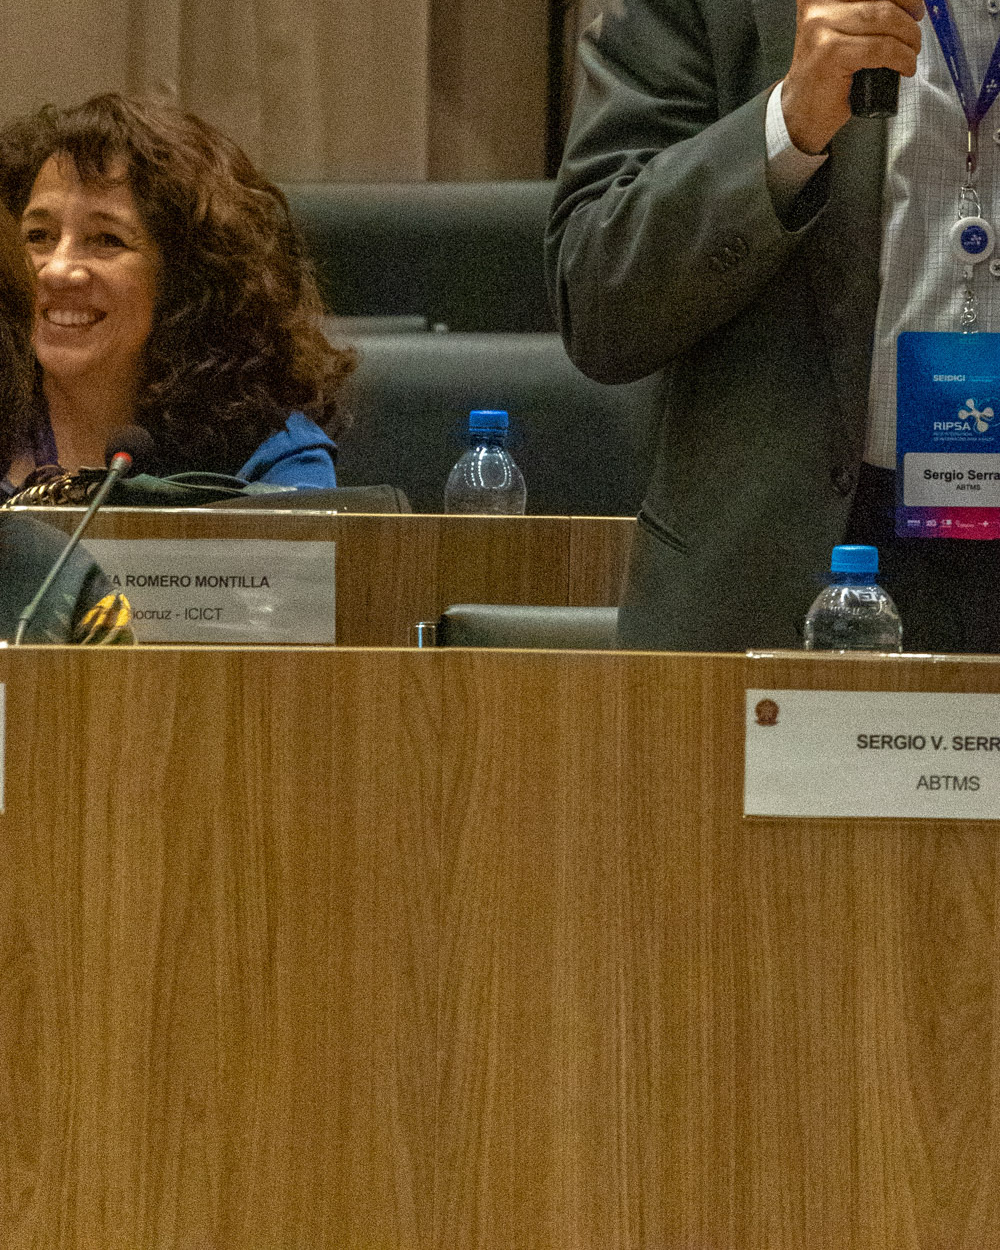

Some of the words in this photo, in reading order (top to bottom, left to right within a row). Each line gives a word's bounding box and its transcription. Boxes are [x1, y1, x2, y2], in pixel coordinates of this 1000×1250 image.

[933, 421, 971, 431] RIPSA
[923, 469, 964, 482] Sergio
[126, 575, 191, 587] ROMERO
[195, 575, 270, 588] MONTILLA
[133, 608, 172, 620] iocruz
[185, 607, 223, 620] ICICT
[856, 734, 926, 751] SERGIO
[930, 735, 947, 751] V.
[917, 776, 981, 791] ABTMS
